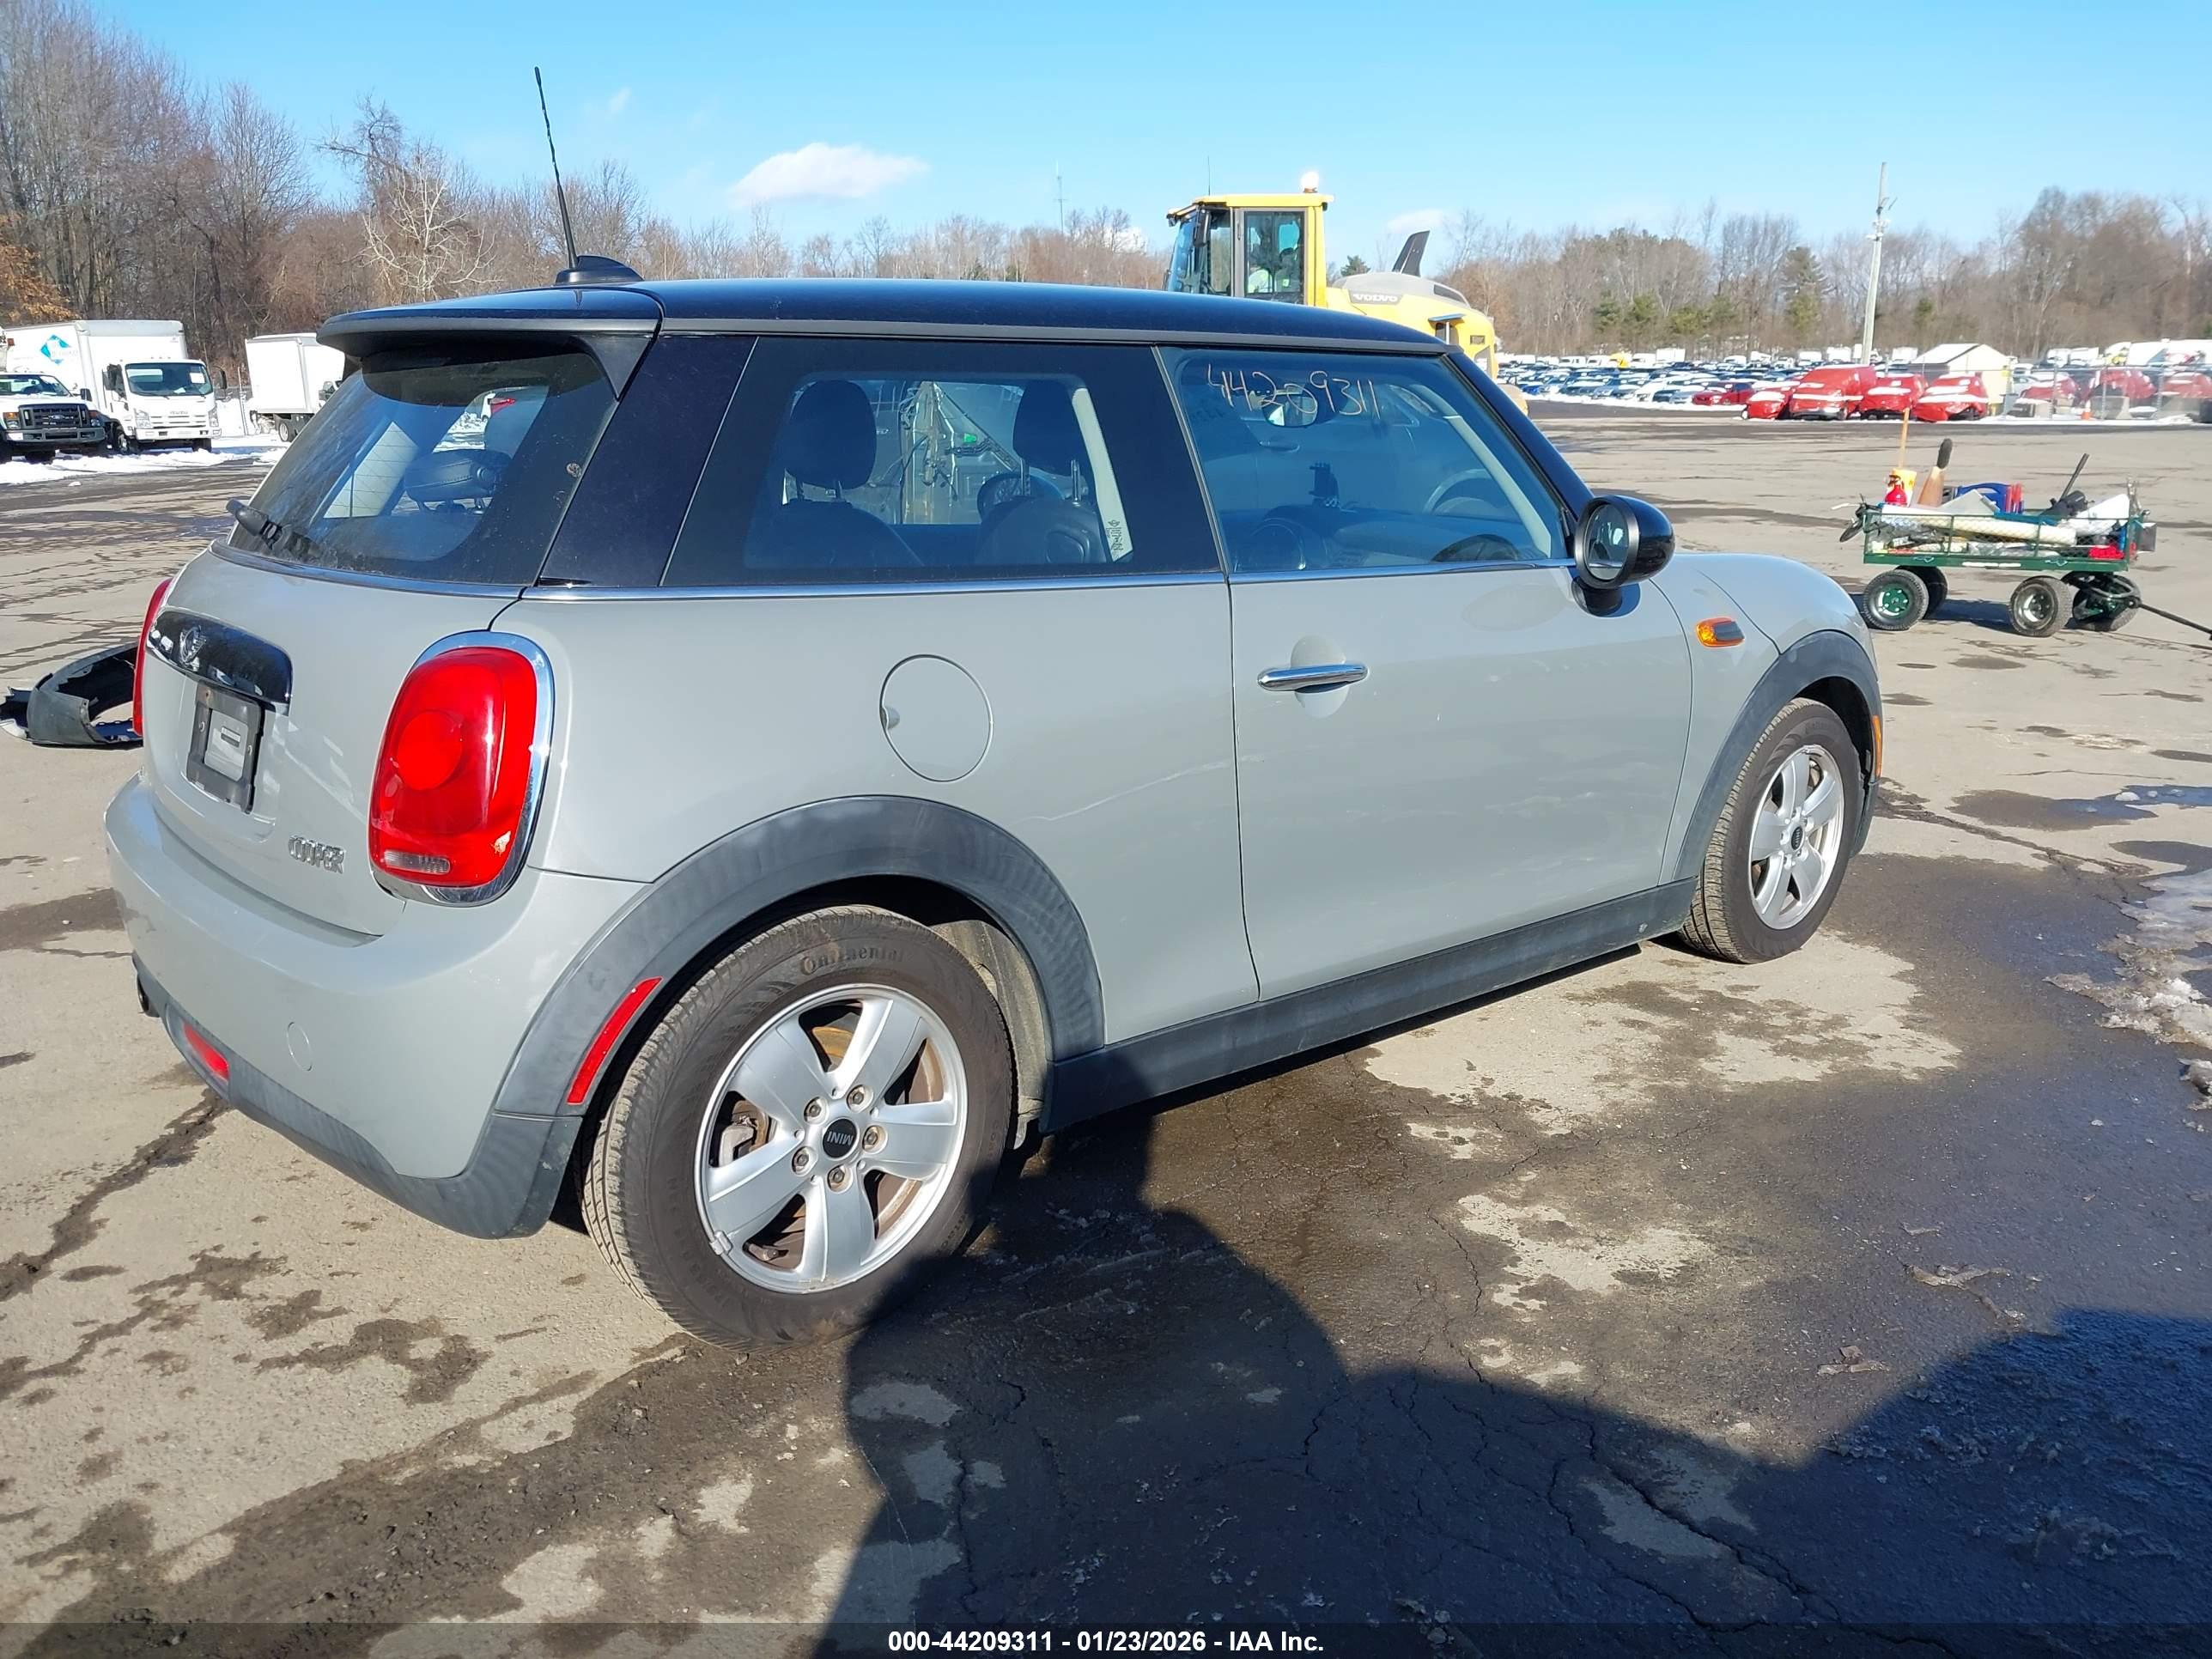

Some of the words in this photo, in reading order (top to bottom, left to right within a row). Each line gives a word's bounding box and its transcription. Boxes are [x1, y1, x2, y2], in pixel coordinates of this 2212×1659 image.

[1352, 294, 1398, 302] VOLVO
[1206, 363, 1381, 419] 44209311
[826, 1130, 854, 1146] MINI
